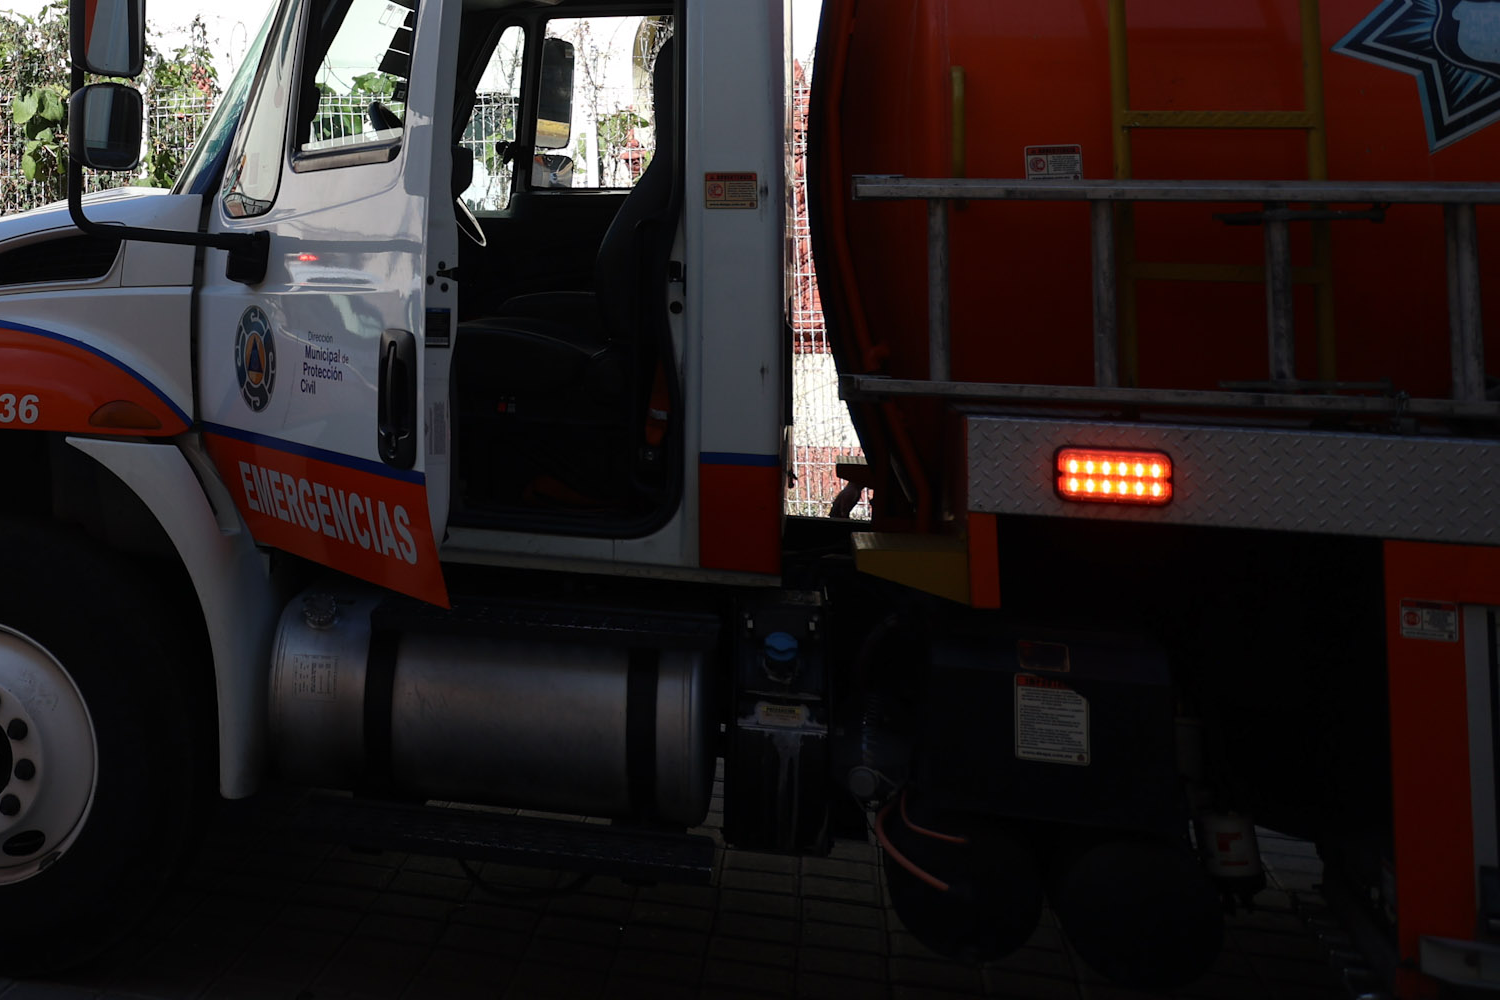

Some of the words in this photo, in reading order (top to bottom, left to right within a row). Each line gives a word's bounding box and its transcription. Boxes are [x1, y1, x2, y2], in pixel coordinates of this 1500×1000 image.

[307, 330, 334, 343] Dirección
[304, 345, 341, 365] Municipal
[341, 354, 349, 363] de
[302, 362, 343, 382] Protección
[300, 379, 316, 394] Civil
[238, 460, 418, 565] EMERGENCIAS
